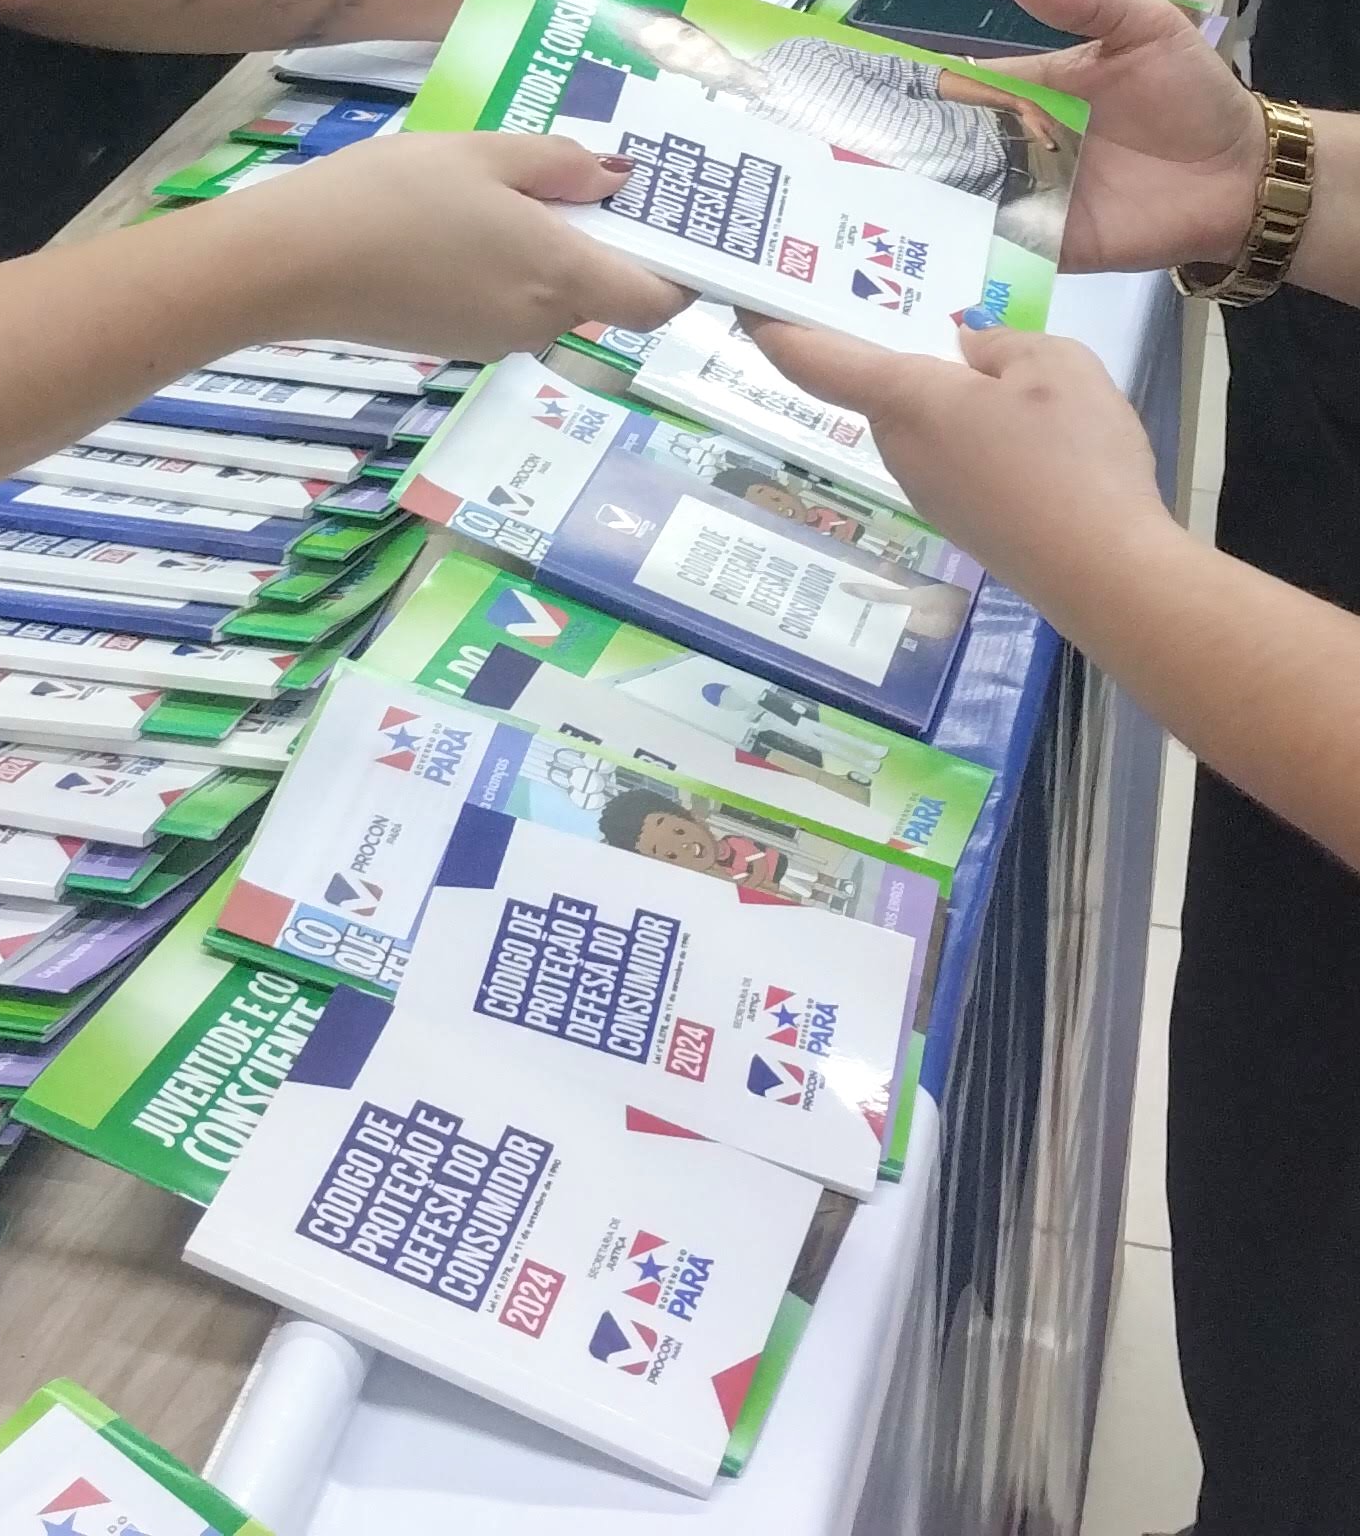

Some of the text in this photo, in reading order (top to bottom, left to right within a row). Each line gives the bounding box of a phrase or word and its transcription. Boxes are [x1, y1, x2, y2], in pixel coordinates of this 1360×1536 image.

[498, 62, 569, 135] VENTUDE
[532, 50, 574, 71] E
[625, 136, 661, 166] DE
[646, 137, 703, 233] PROTEÇÃO E
[684, 160, 736, 247] DEFESA DO
[722, 157, 777, 259] CONSUMIDOR
[780, 239, 815, 279] 2024
[350, 814, 390, 874] PROCON
[482, 904, 547, 1019] CÓDIGO DE
[524, 899, 592, 1033] PROTEÇÃO E
[564, 925, 628, 1045] DEFESA DO
[606, 914, 674, 1058] CONSUMIDOR
[131, 970, 301, 1148] JUVENTUDE E CO
[181, 996, 327, 1173] CONSCIENTE
[670, 1024, 710, 1077] 2024
[308, 1110, 404, 1245] CÓDIGO DE
[350, 1109, 456, 1265] PROTEÇÃO E
[392, 1143, 489, 1284] DEFESA DO
[437, 1133, 546, 1303] CONSUMIDOR
[505, 1266, 558, 1332] 2024
[646, 1334, 675, 1386] PROCON
